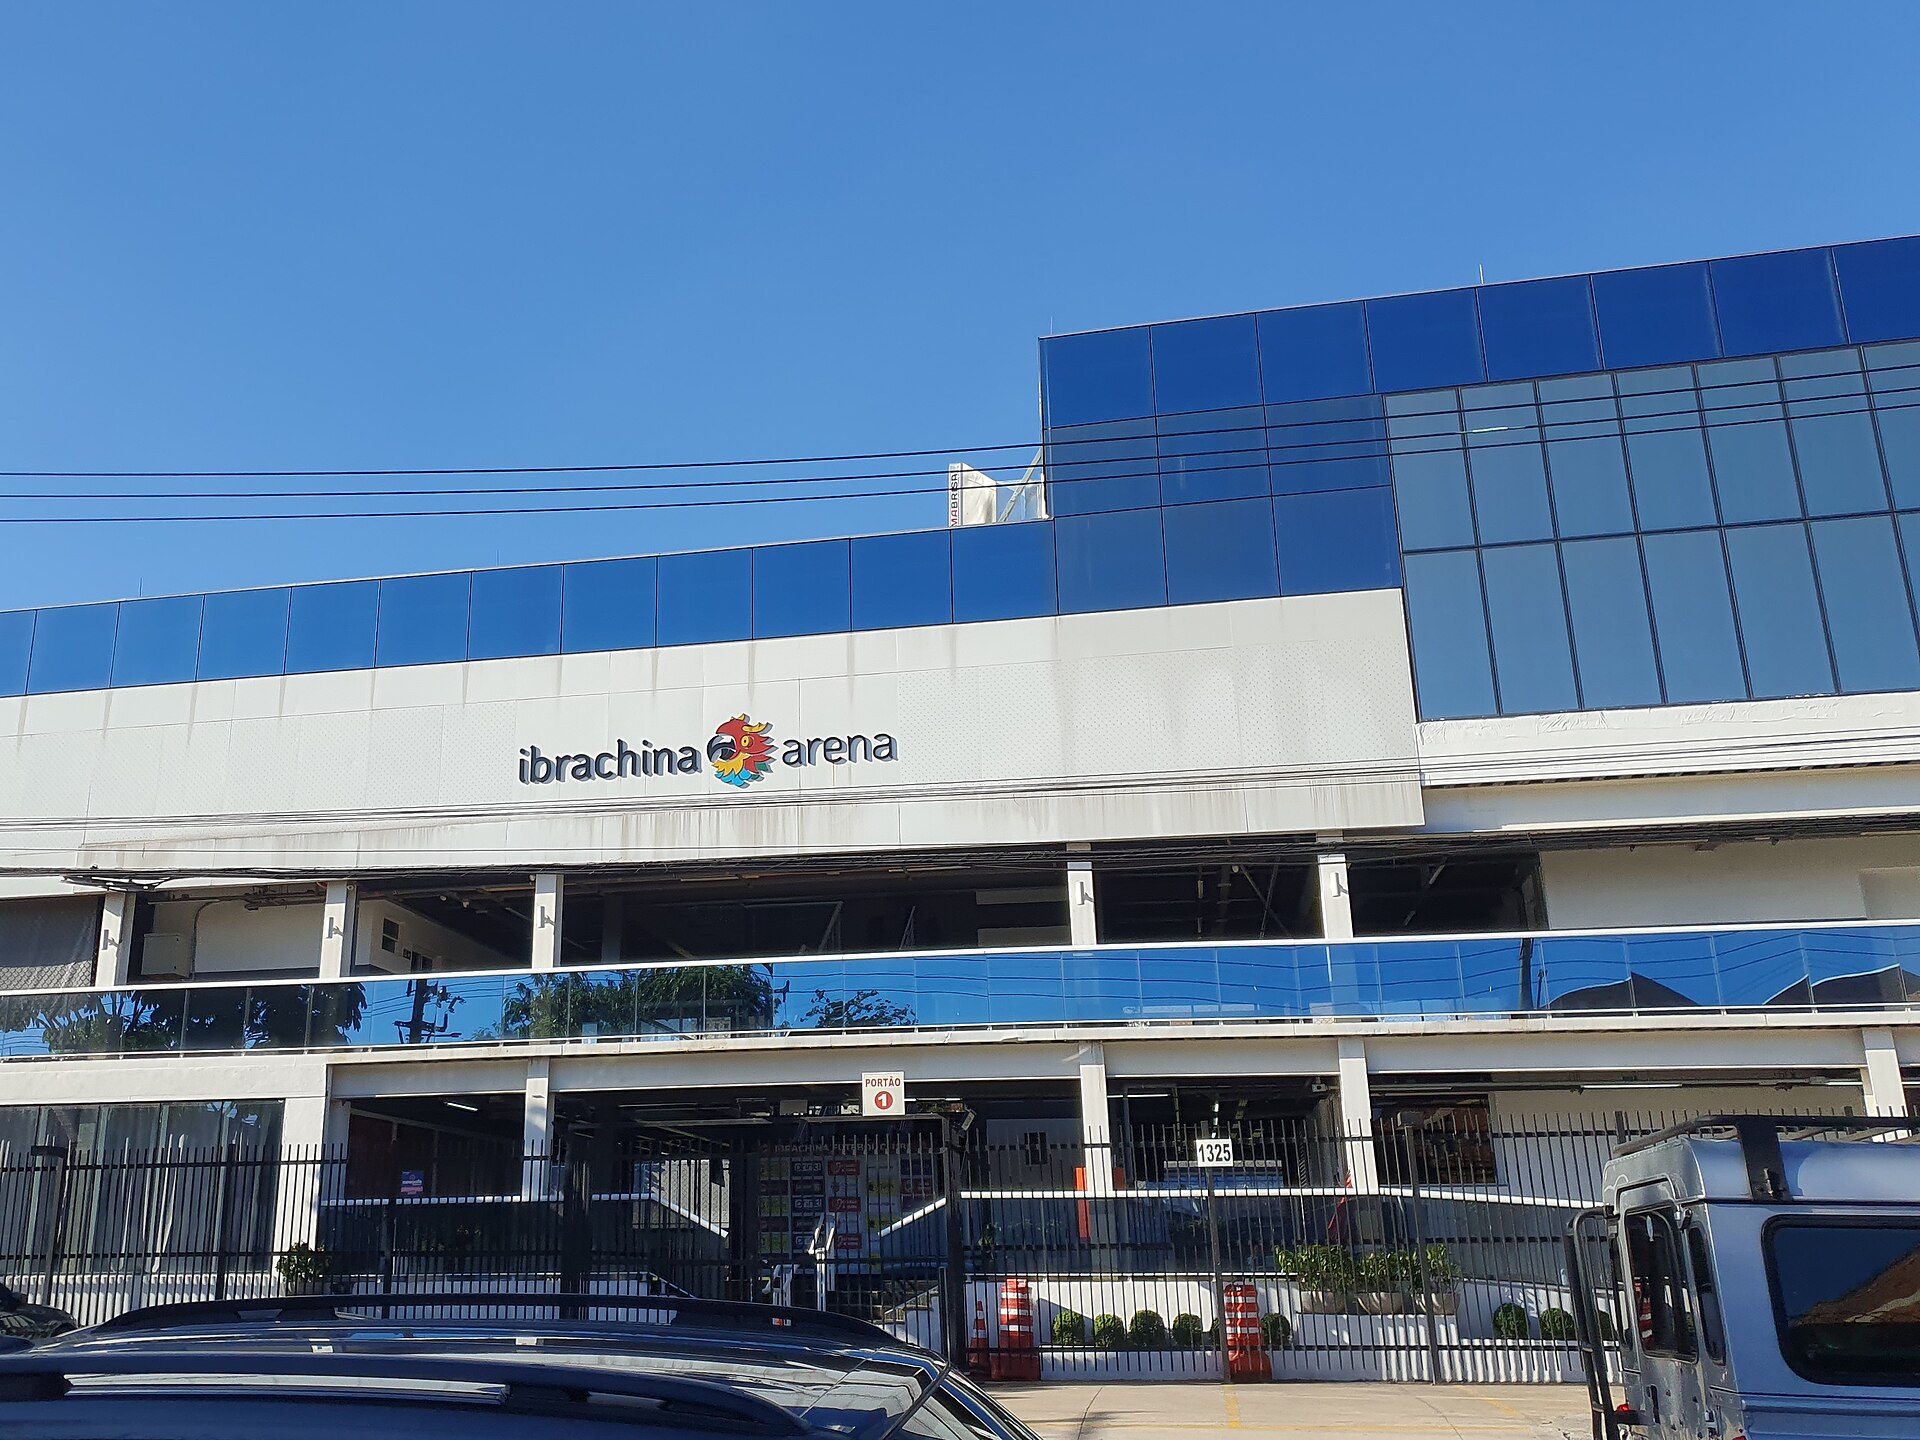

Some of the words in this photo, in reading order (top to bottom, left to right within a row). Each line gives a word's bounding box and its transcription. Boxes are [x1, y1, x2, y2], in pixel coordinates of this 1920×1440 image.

[519, 738, 702, 785] ibrachina
[782, 732, 899, 769] arena
[865, 1076, 901, 1087] PORTÃO
[878, 1093, 887, 1107] 1
[1199, 1143, 1231, 1162] 1325
